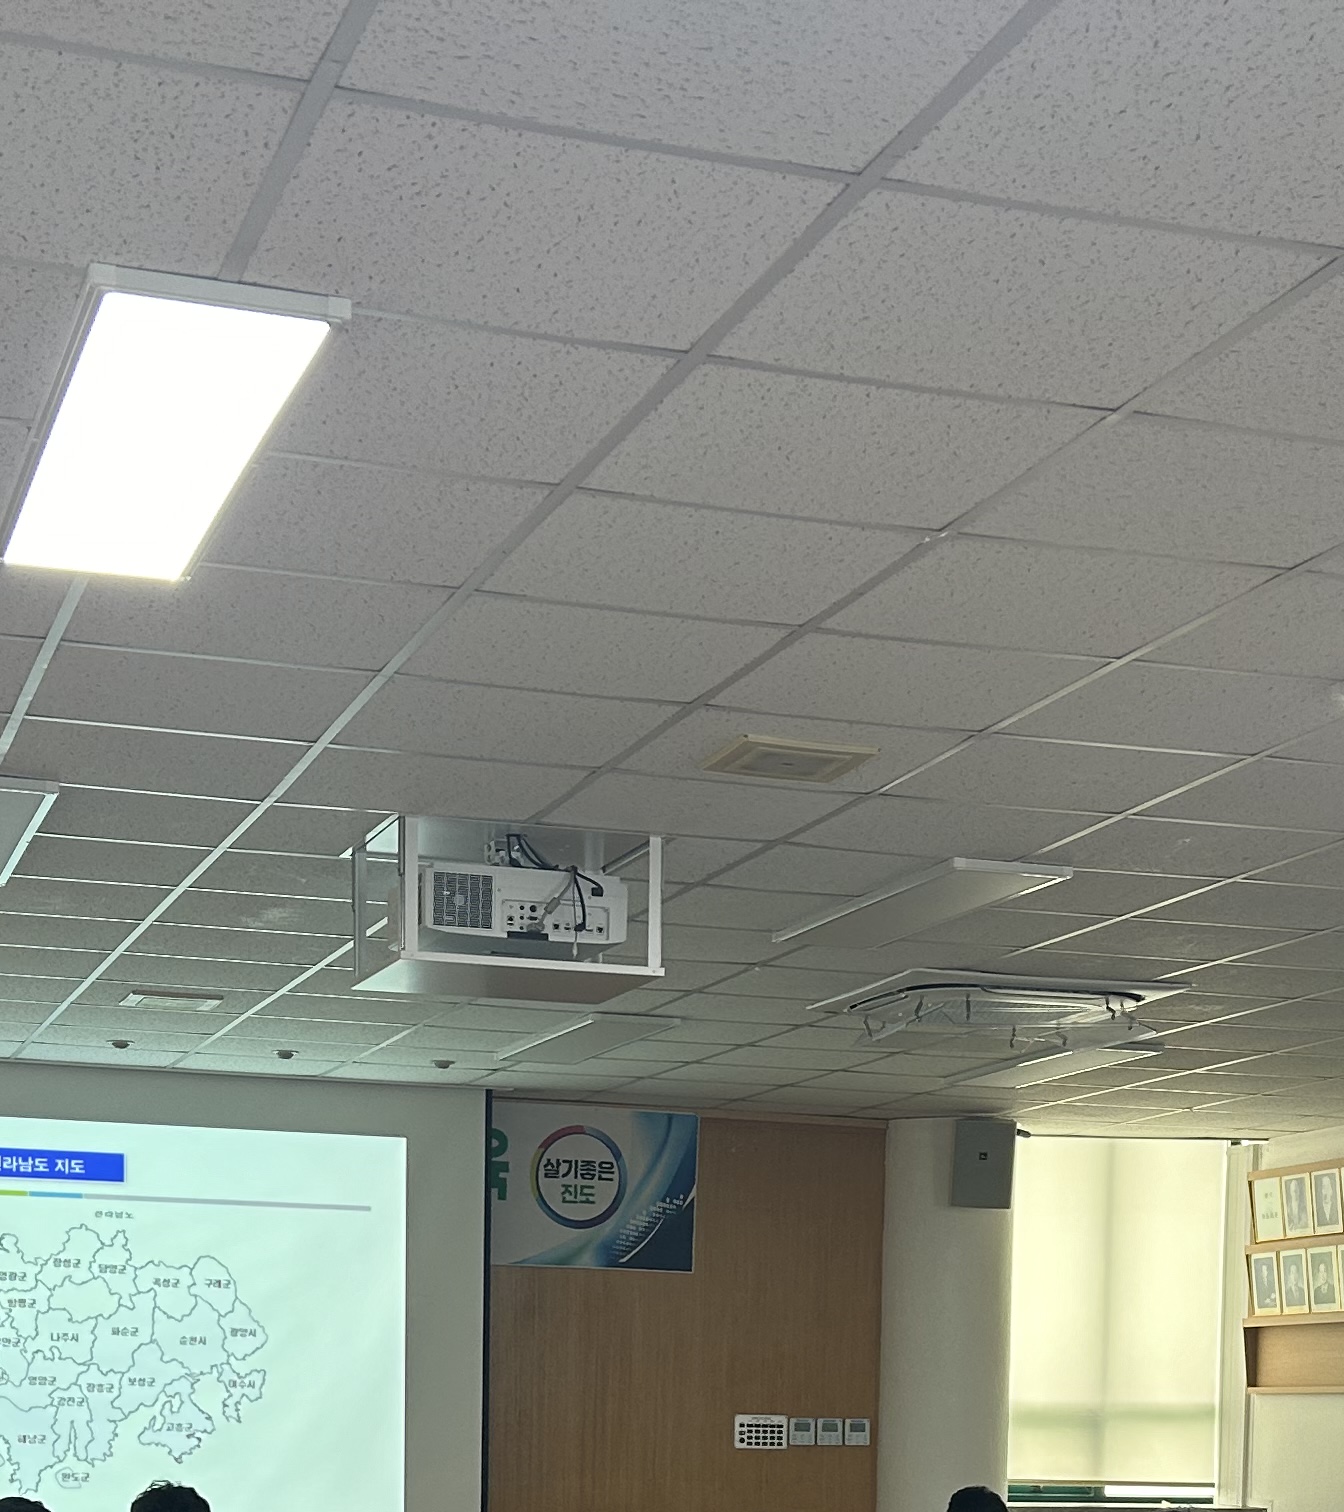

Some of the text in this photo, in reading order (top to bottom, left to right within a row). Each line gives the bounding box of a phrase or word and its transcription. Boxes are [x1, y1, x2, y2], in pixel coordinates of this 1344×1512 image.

[54, 1158, 85, 1174] 지도
[543, 1158, 616, 1182] 살기좋은
[561, 1183, 596, 1205] 진도
[50, 1332, 79, 1342] 나주시
